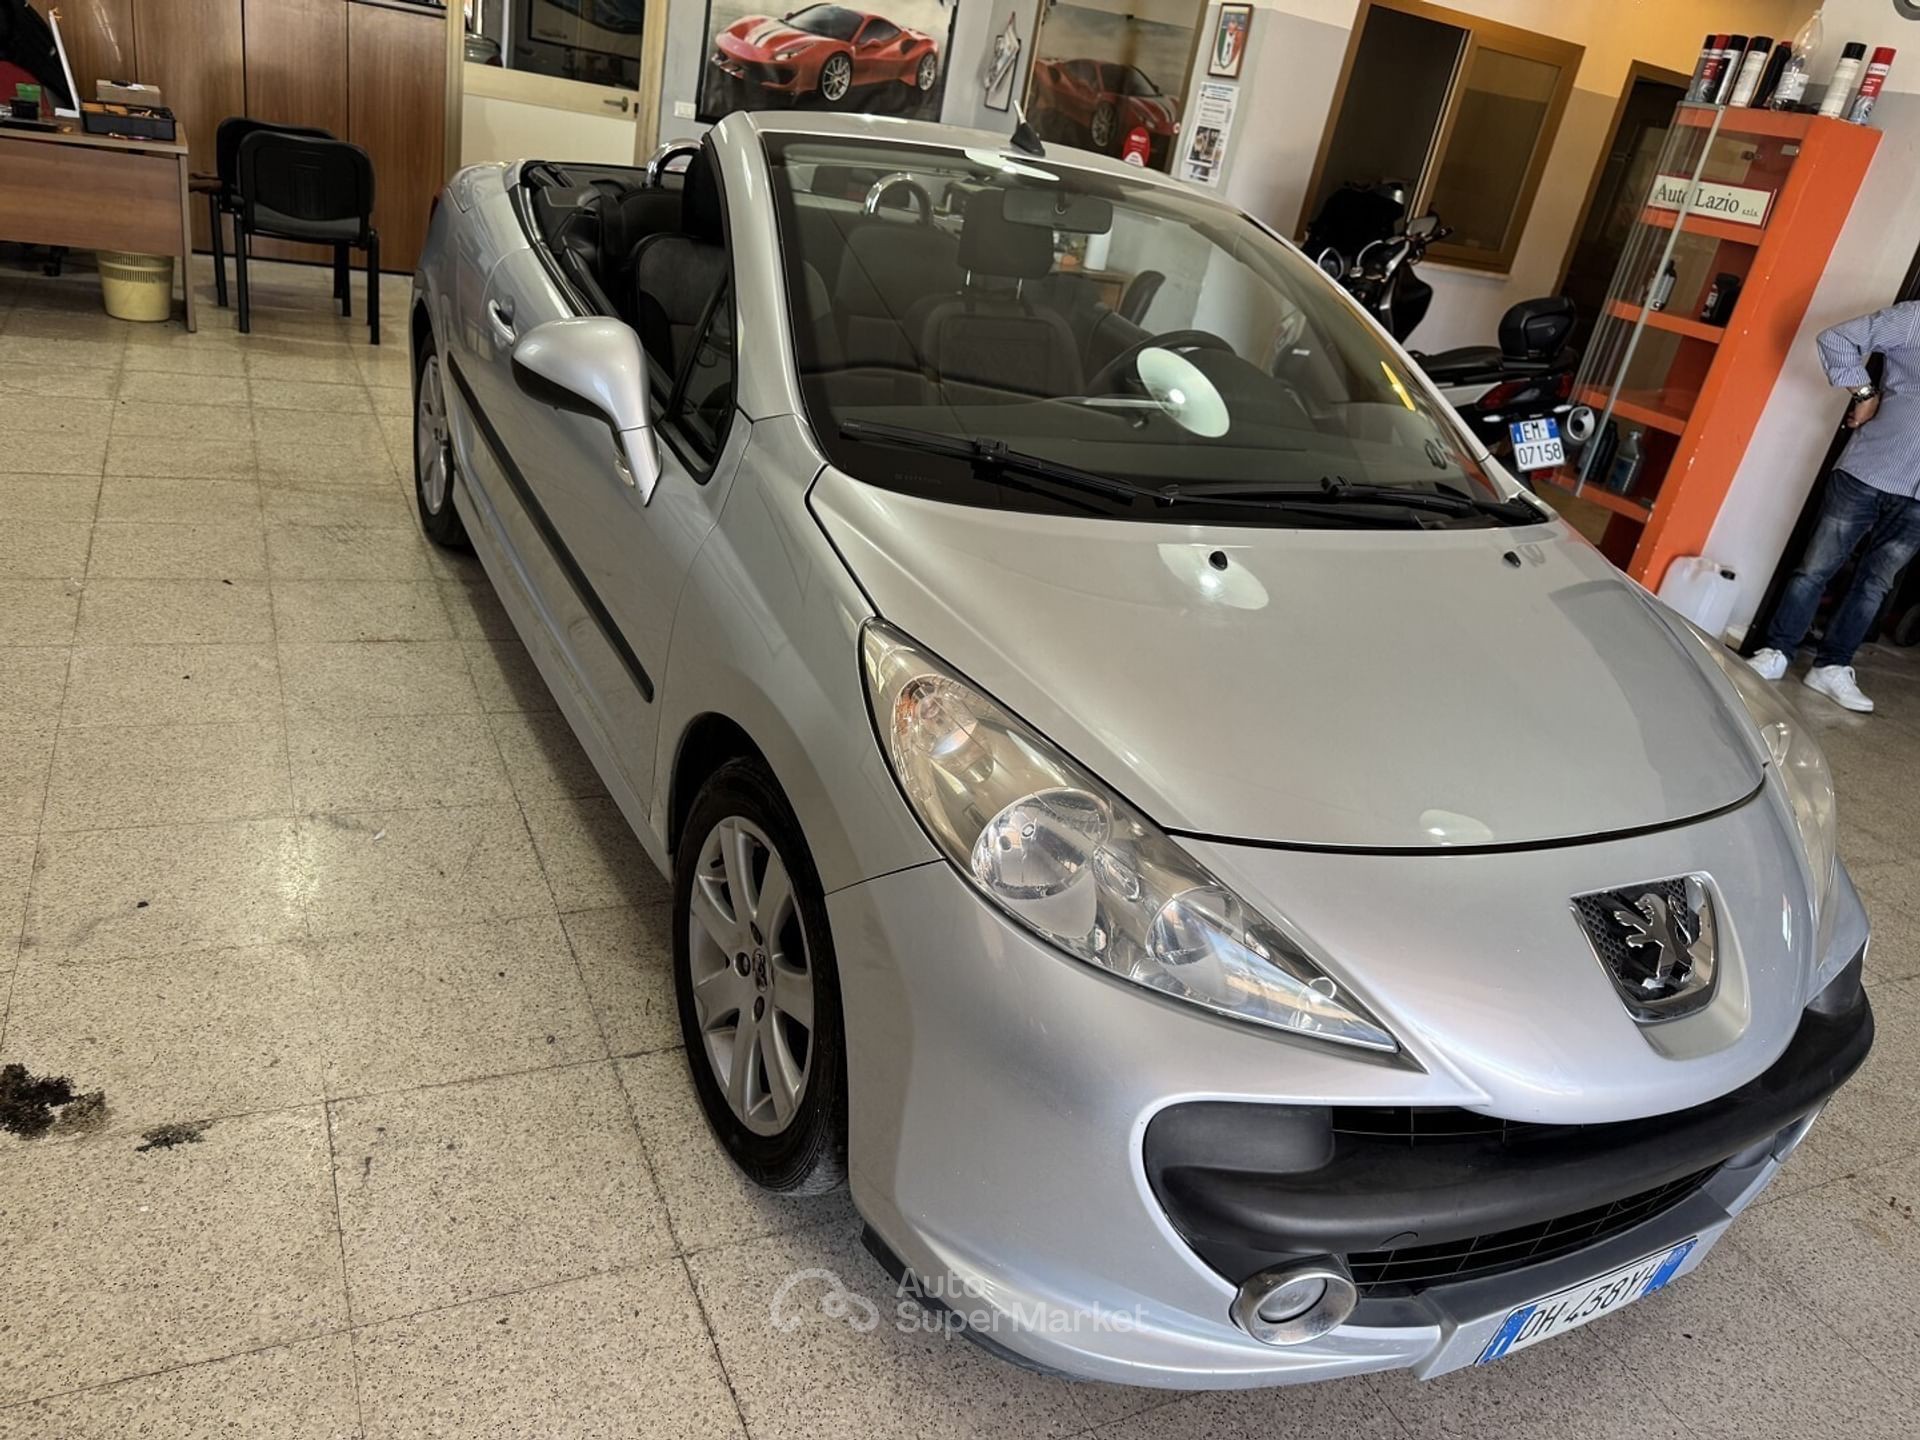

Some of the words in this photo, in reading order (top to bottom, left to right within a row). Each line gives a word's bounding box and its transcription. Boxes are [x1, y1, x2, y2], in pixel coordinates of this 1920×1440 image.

[1694, 188, 1740, 213] Lazio
[1522, 421, 1542, 440] EM
[1518, 442, 1562, 465] 07158
[1514, 1302, 1567, 1343] DH
[1564, 1259, 1665, 1322] 438YH
